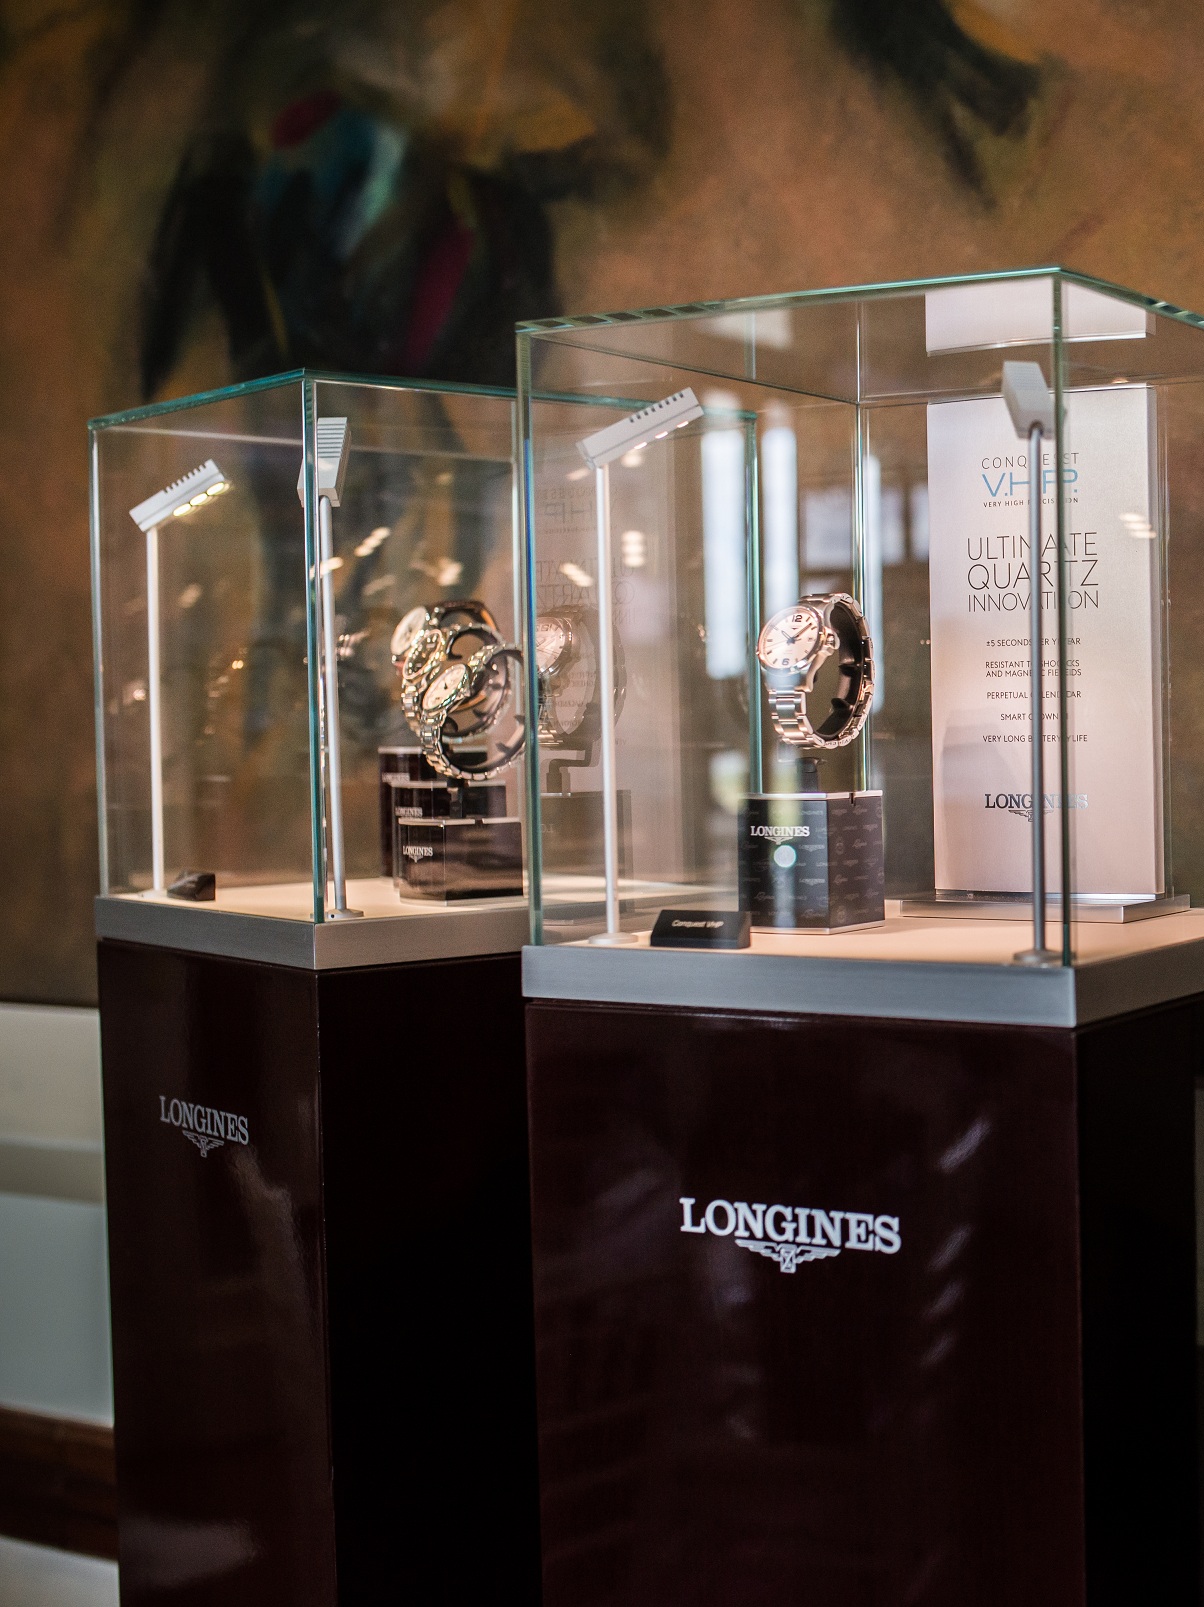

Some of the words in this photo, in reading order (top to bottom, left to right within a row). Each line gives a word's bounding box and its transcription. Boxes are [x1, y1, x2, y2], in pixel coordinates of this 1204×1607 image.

[981, 452, 1079, 470] CONQEST
[981, 468, 1079, 497] V.HP.
[1027, 498, 1079, 506] CISON
[967, 559, 1099, 590] QUARTZ
[968, 589, 1099, 613] INNOVTION
[997, 638, 1033, 647] SECONDS
[985, 660, 1025, 669] RESISTANT
[985, 670, 1003, 678] AND
[1004, 668, 1046, 678] MAGNEC
[986, 690, 1029, 699] PERPETUAL
[1030, 690, 1082, 699] LENDAR
[1000, 712, 1026, 721] SMART
[1027, 712, 1060, 721] COWN
[982, 734, 1002, 743] VERY
[1003, 734, 1026, 743] LONG
[1027, 734, 1064, 743] BTERY
[1071, 734, 1088, 742] LIFE
[984, 793, 1089, 810] LONGNES
[750, 825, 811, 837] LONGINES
[402, 845, 434, 857] LONGINES
[159, 1095, 250, 1146] LONGINES
[679, 1197, 903, 1254] LONGINES
